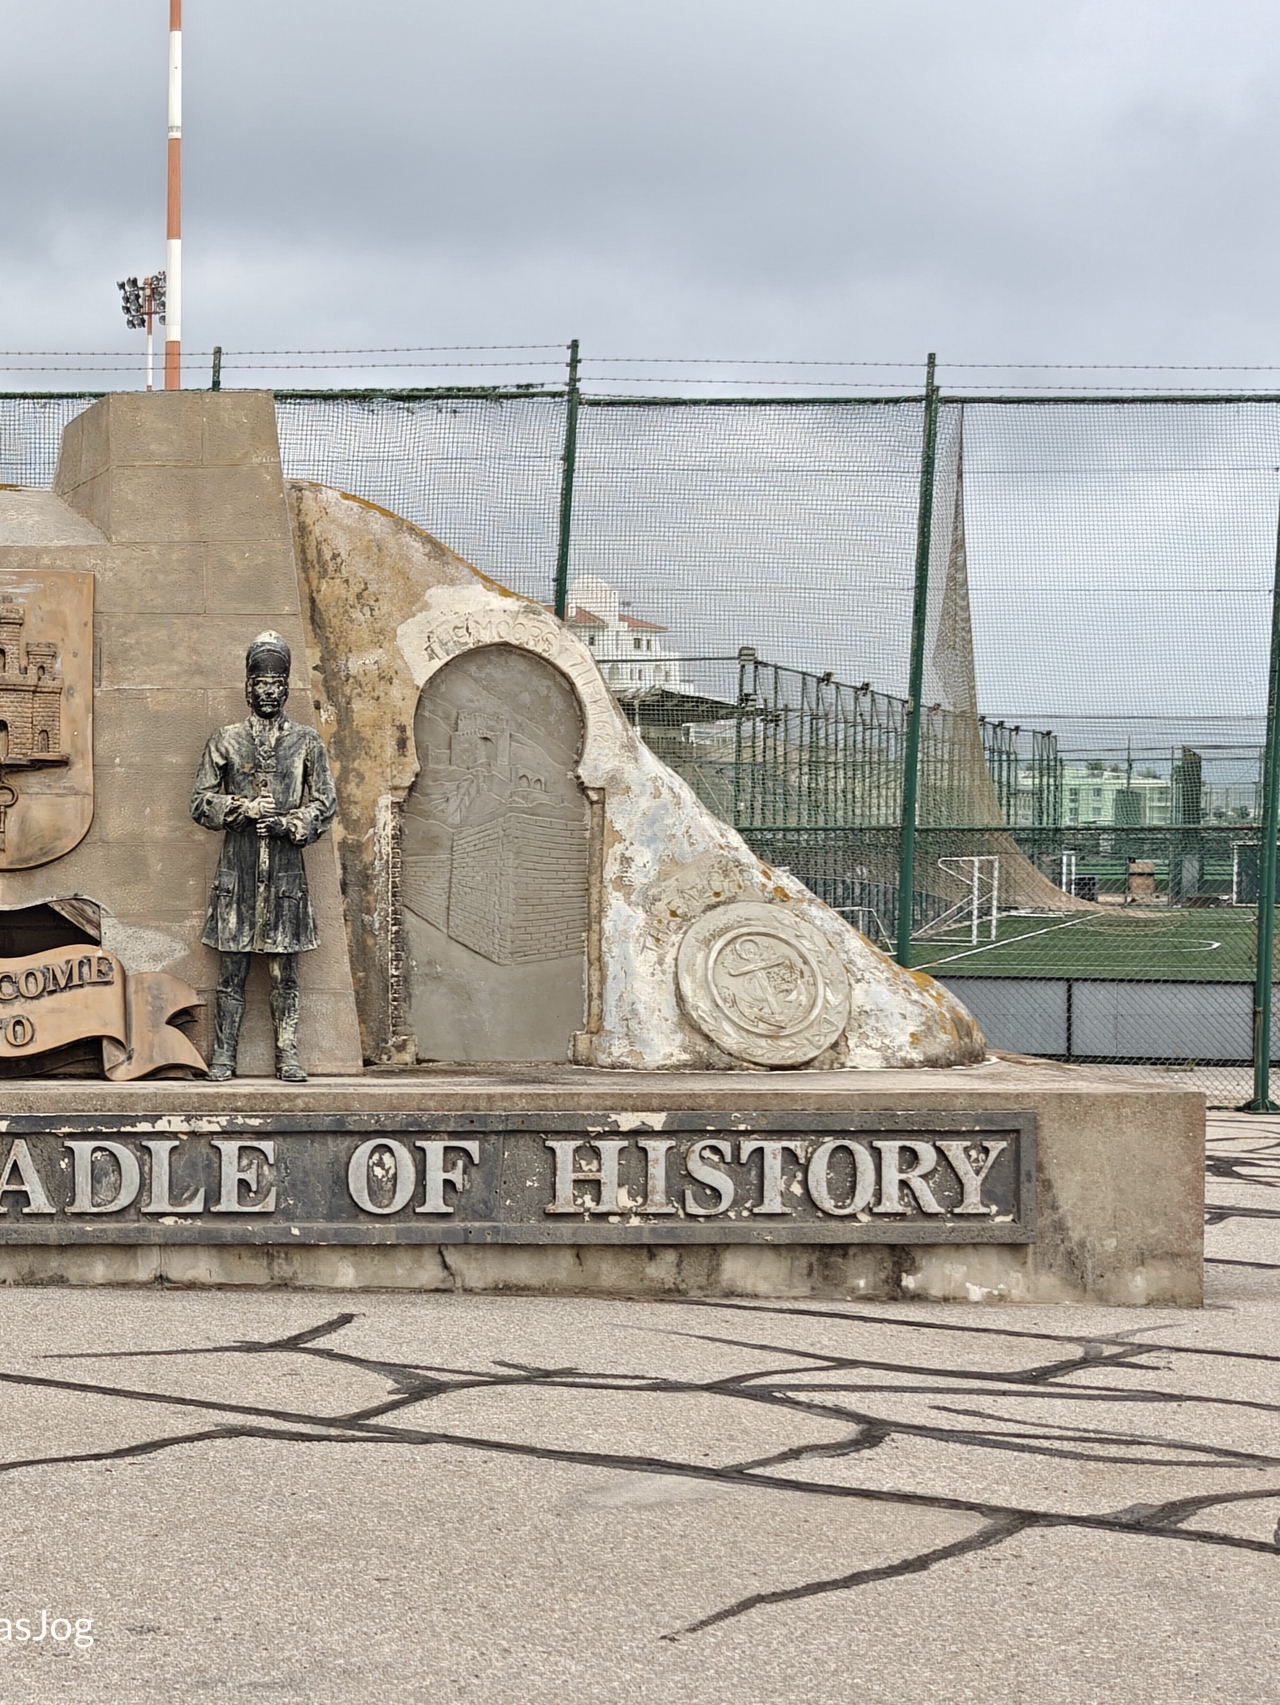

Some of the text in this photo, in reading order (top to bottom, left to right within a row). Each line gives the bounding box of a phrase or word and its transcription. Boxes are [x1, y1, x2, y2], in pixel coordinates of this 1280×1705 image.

[424, 623, 467, 661] THE
[473, 619, 558, 656] MOORS
[346, 1138, 481, 1216] OF
[545, 1138, 1009, 1217] HISTORY
